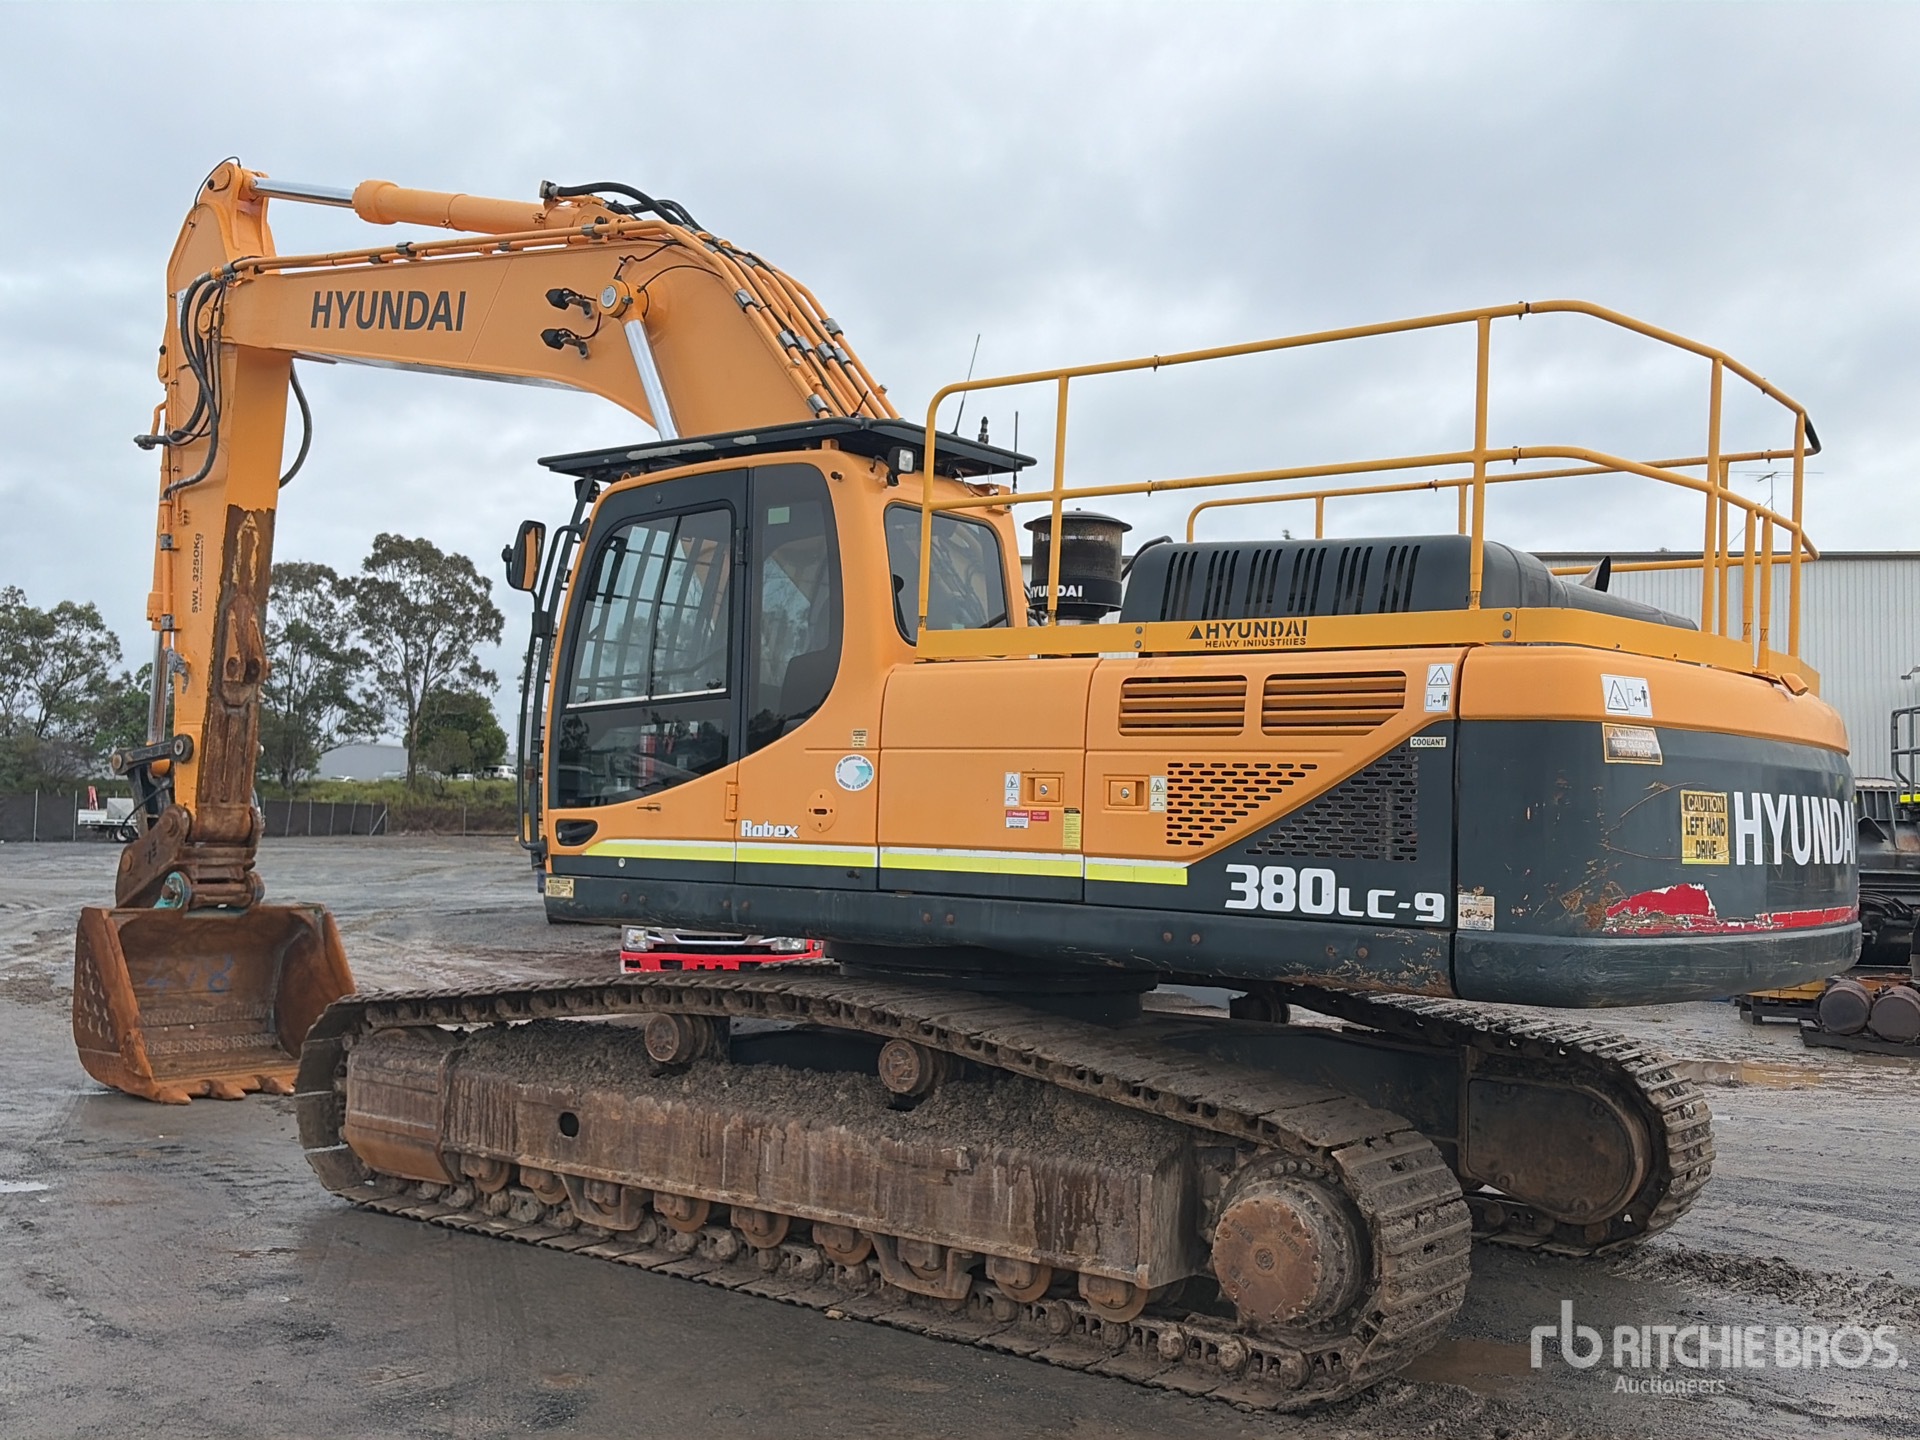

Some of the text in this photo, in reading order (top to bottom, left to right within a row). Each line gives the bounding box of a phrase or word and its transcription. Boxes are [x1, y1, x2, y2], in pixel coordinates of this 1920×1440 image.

[311, 291, 466, 331] HYUNDAI
[1030, 585, 1083, 598] HYUDAI
[1206, 620, 1308, 639] HYUNDAI
[1205, 638, 1307, 649] HEAVY INDUSTRIES
[1411, 738, 1445, 746] COOLANT
[1687, 795, 1724, 812] CAUTION
[741, 820, 799, 838] Robex
[1686, 816, 1726, 837] LEFT HAND
[1734, 792, 1857, 866] HYUNDAI
[1695, 840, 1717, 859] DRIVE
